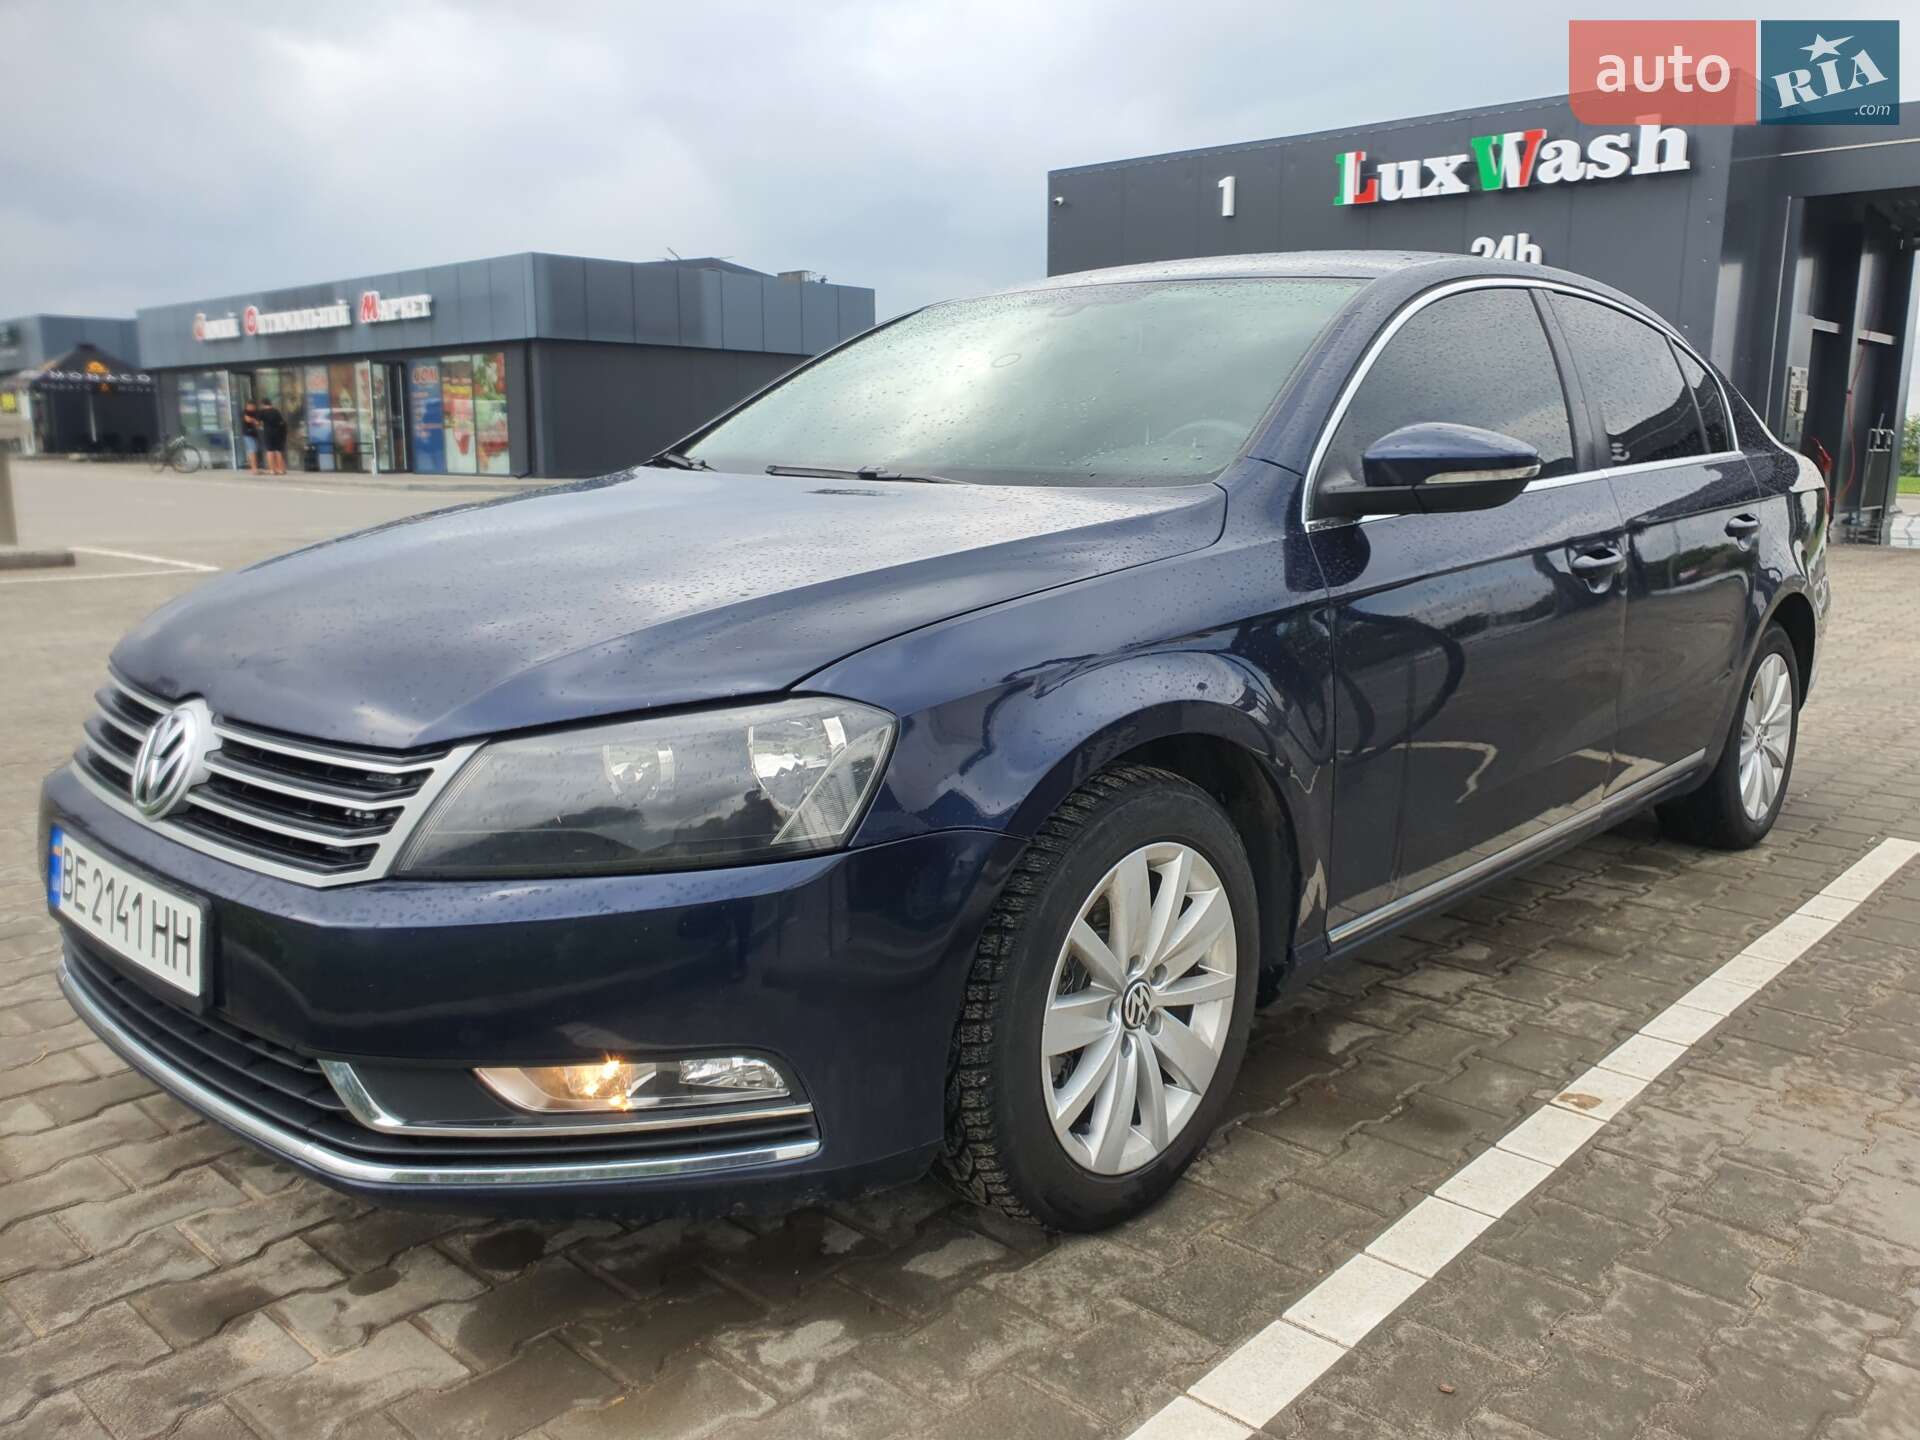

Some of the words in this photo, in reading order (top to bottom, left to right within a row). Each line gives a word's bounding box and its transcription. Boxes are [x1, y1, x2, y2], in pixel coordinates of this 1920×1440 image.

[1217, 175, 1236, 217] 1
[1470, 232, 1543, 265] 24h
[91, 867, 143, 950] 2141
